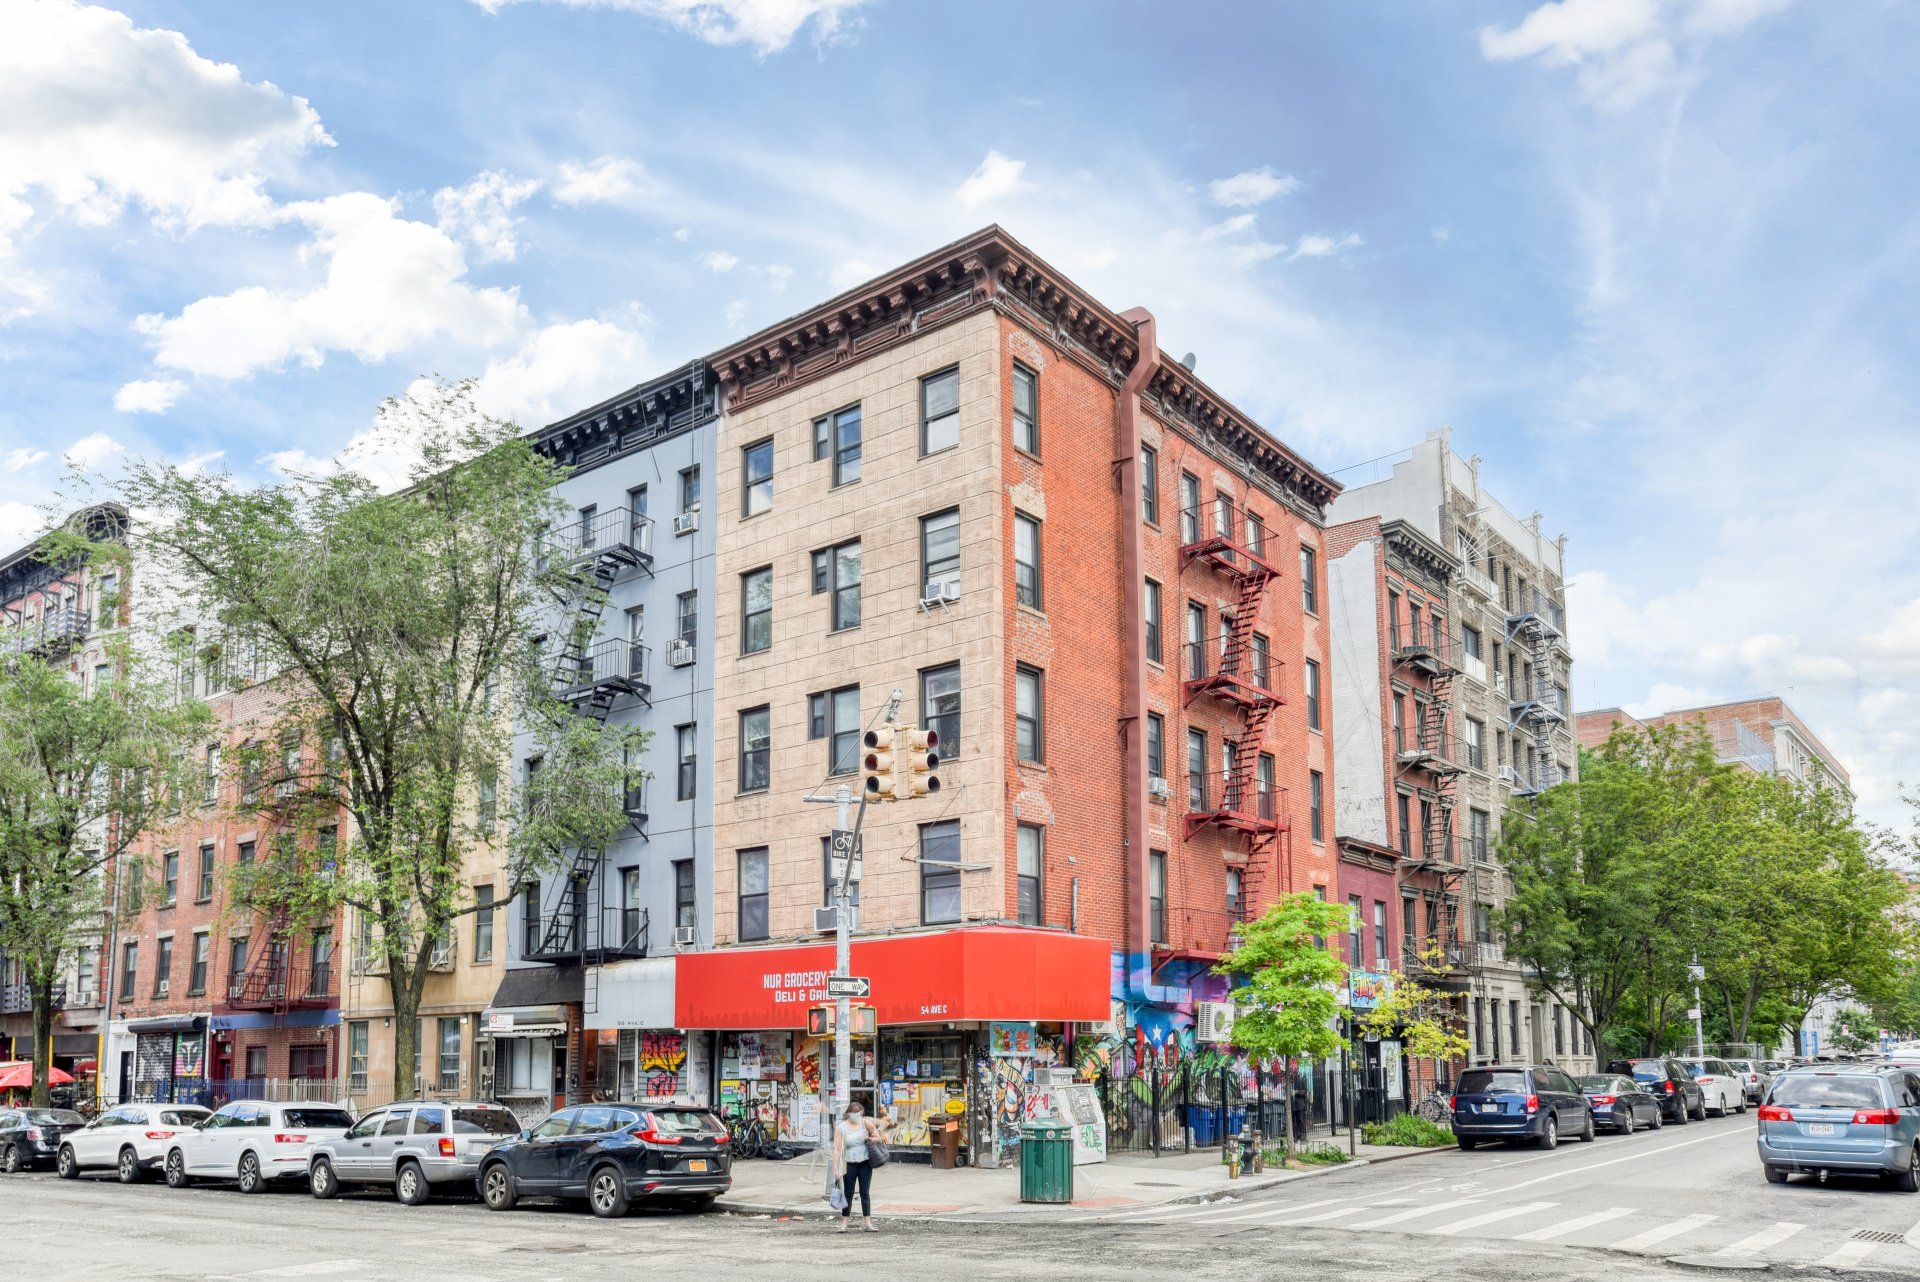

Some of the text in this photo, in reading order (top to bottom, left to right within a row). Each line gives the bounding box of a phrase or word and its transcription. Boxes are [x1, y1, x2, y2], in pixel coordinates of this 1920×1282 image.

[833, 850, 846, 858] BIKE
[763, 971, 826, 989] NUR GROCERY
[830, 982, 865, 991] ONE WAY
[799, 989, 807, 1002] &
[809, 988, 838, 1001] GRIL
[920, 1005, 947, 1015] 54 AVE C
[1061, 1076, 1071, 1084] ICE
